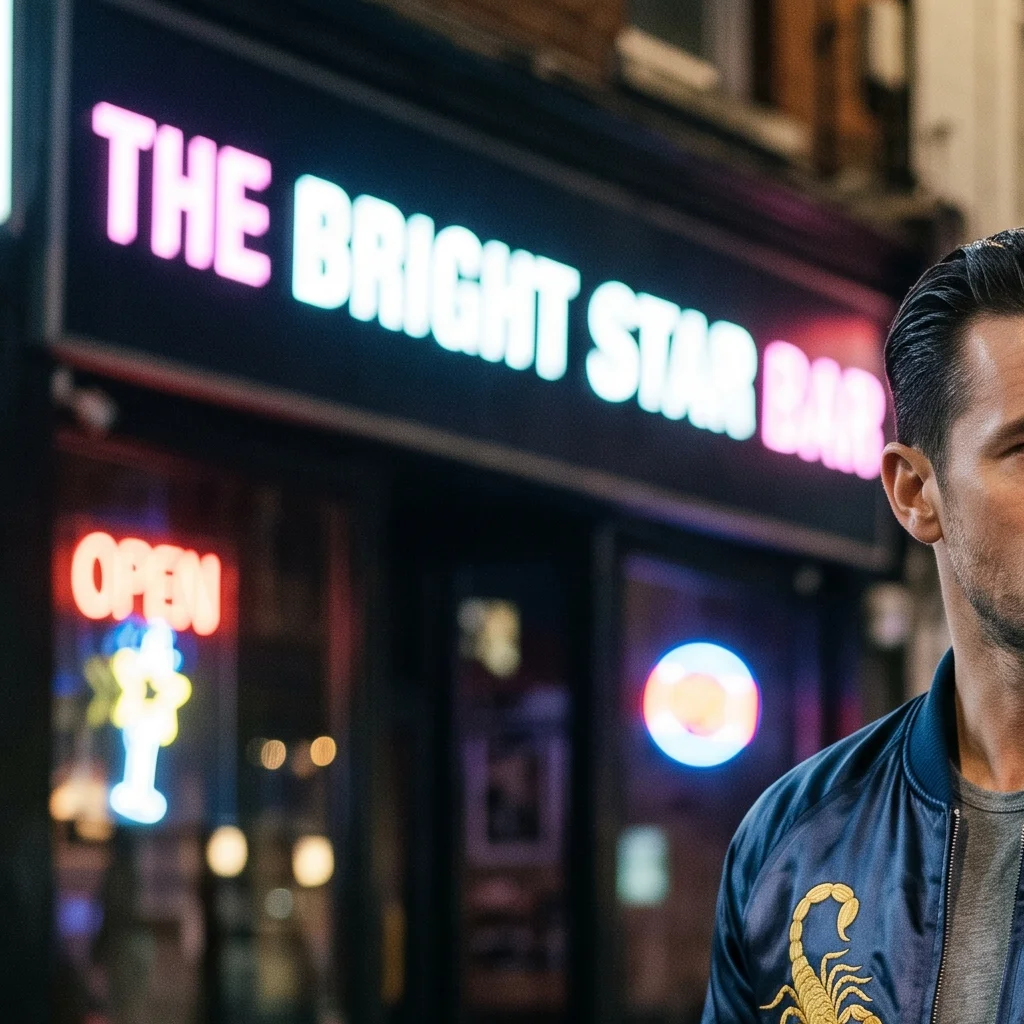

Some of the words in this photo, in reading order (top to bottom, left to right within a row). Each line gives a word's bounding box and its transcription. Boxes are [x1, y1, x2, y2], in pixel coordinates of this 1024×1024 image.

[92, 101, 272, 288] THE
[292, 174, 581, 381] BRIGHT
[586, 281, 758, 441] STAR
[763, 341, 885, 479] BAR
[71, 531, 222, 636] OPEN
